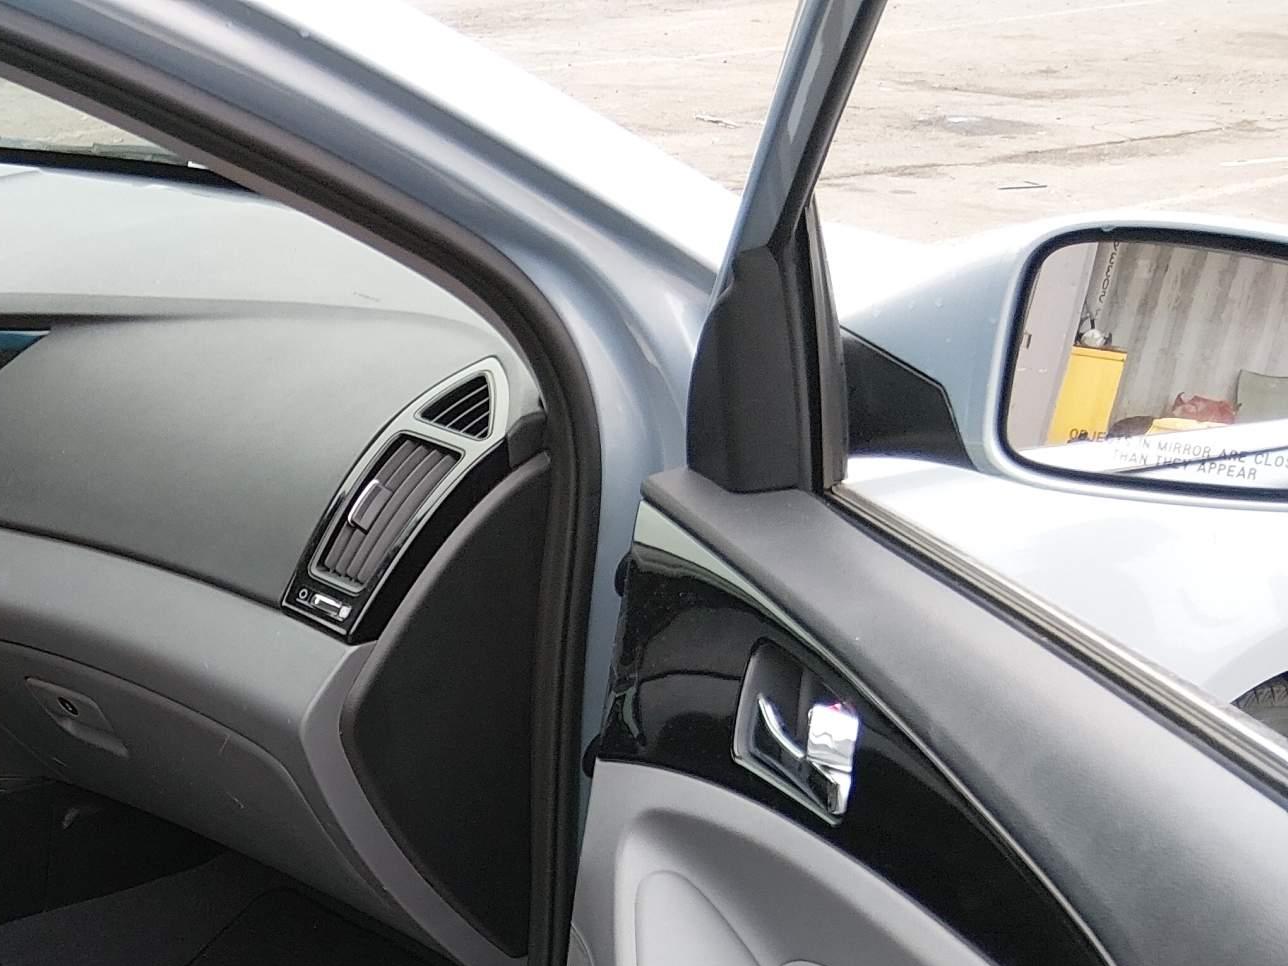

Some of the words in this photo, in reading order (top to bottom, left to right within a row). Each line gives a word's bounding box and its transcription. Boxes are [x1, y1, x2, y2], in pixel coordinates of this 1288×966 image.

[1157, 441, 1212, 458] MIRROR
[1220, 448, 1246, 463] ARE
[1197, 461, 1257, 481] APPEAR
